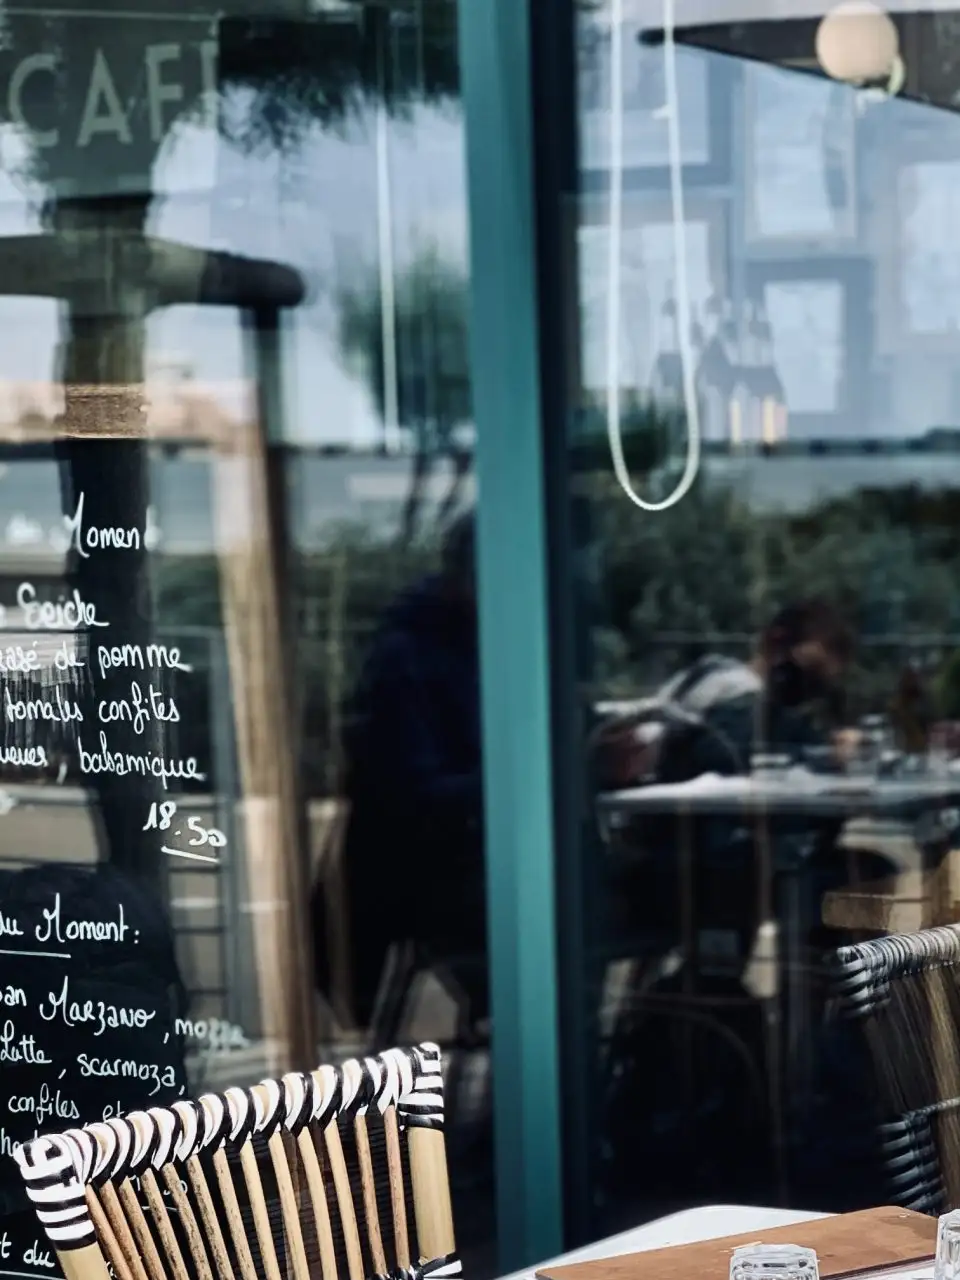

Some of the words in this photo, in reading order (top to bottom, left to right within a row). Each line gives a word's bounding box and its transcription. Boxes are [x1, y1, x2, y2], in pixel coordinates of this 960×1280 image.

[98, 643, 194, 680] pomme
[98, 681, 180, 734] confites
[77, 731, 206, 790] balsamique
[142, 800, 228, 847] 18.50
